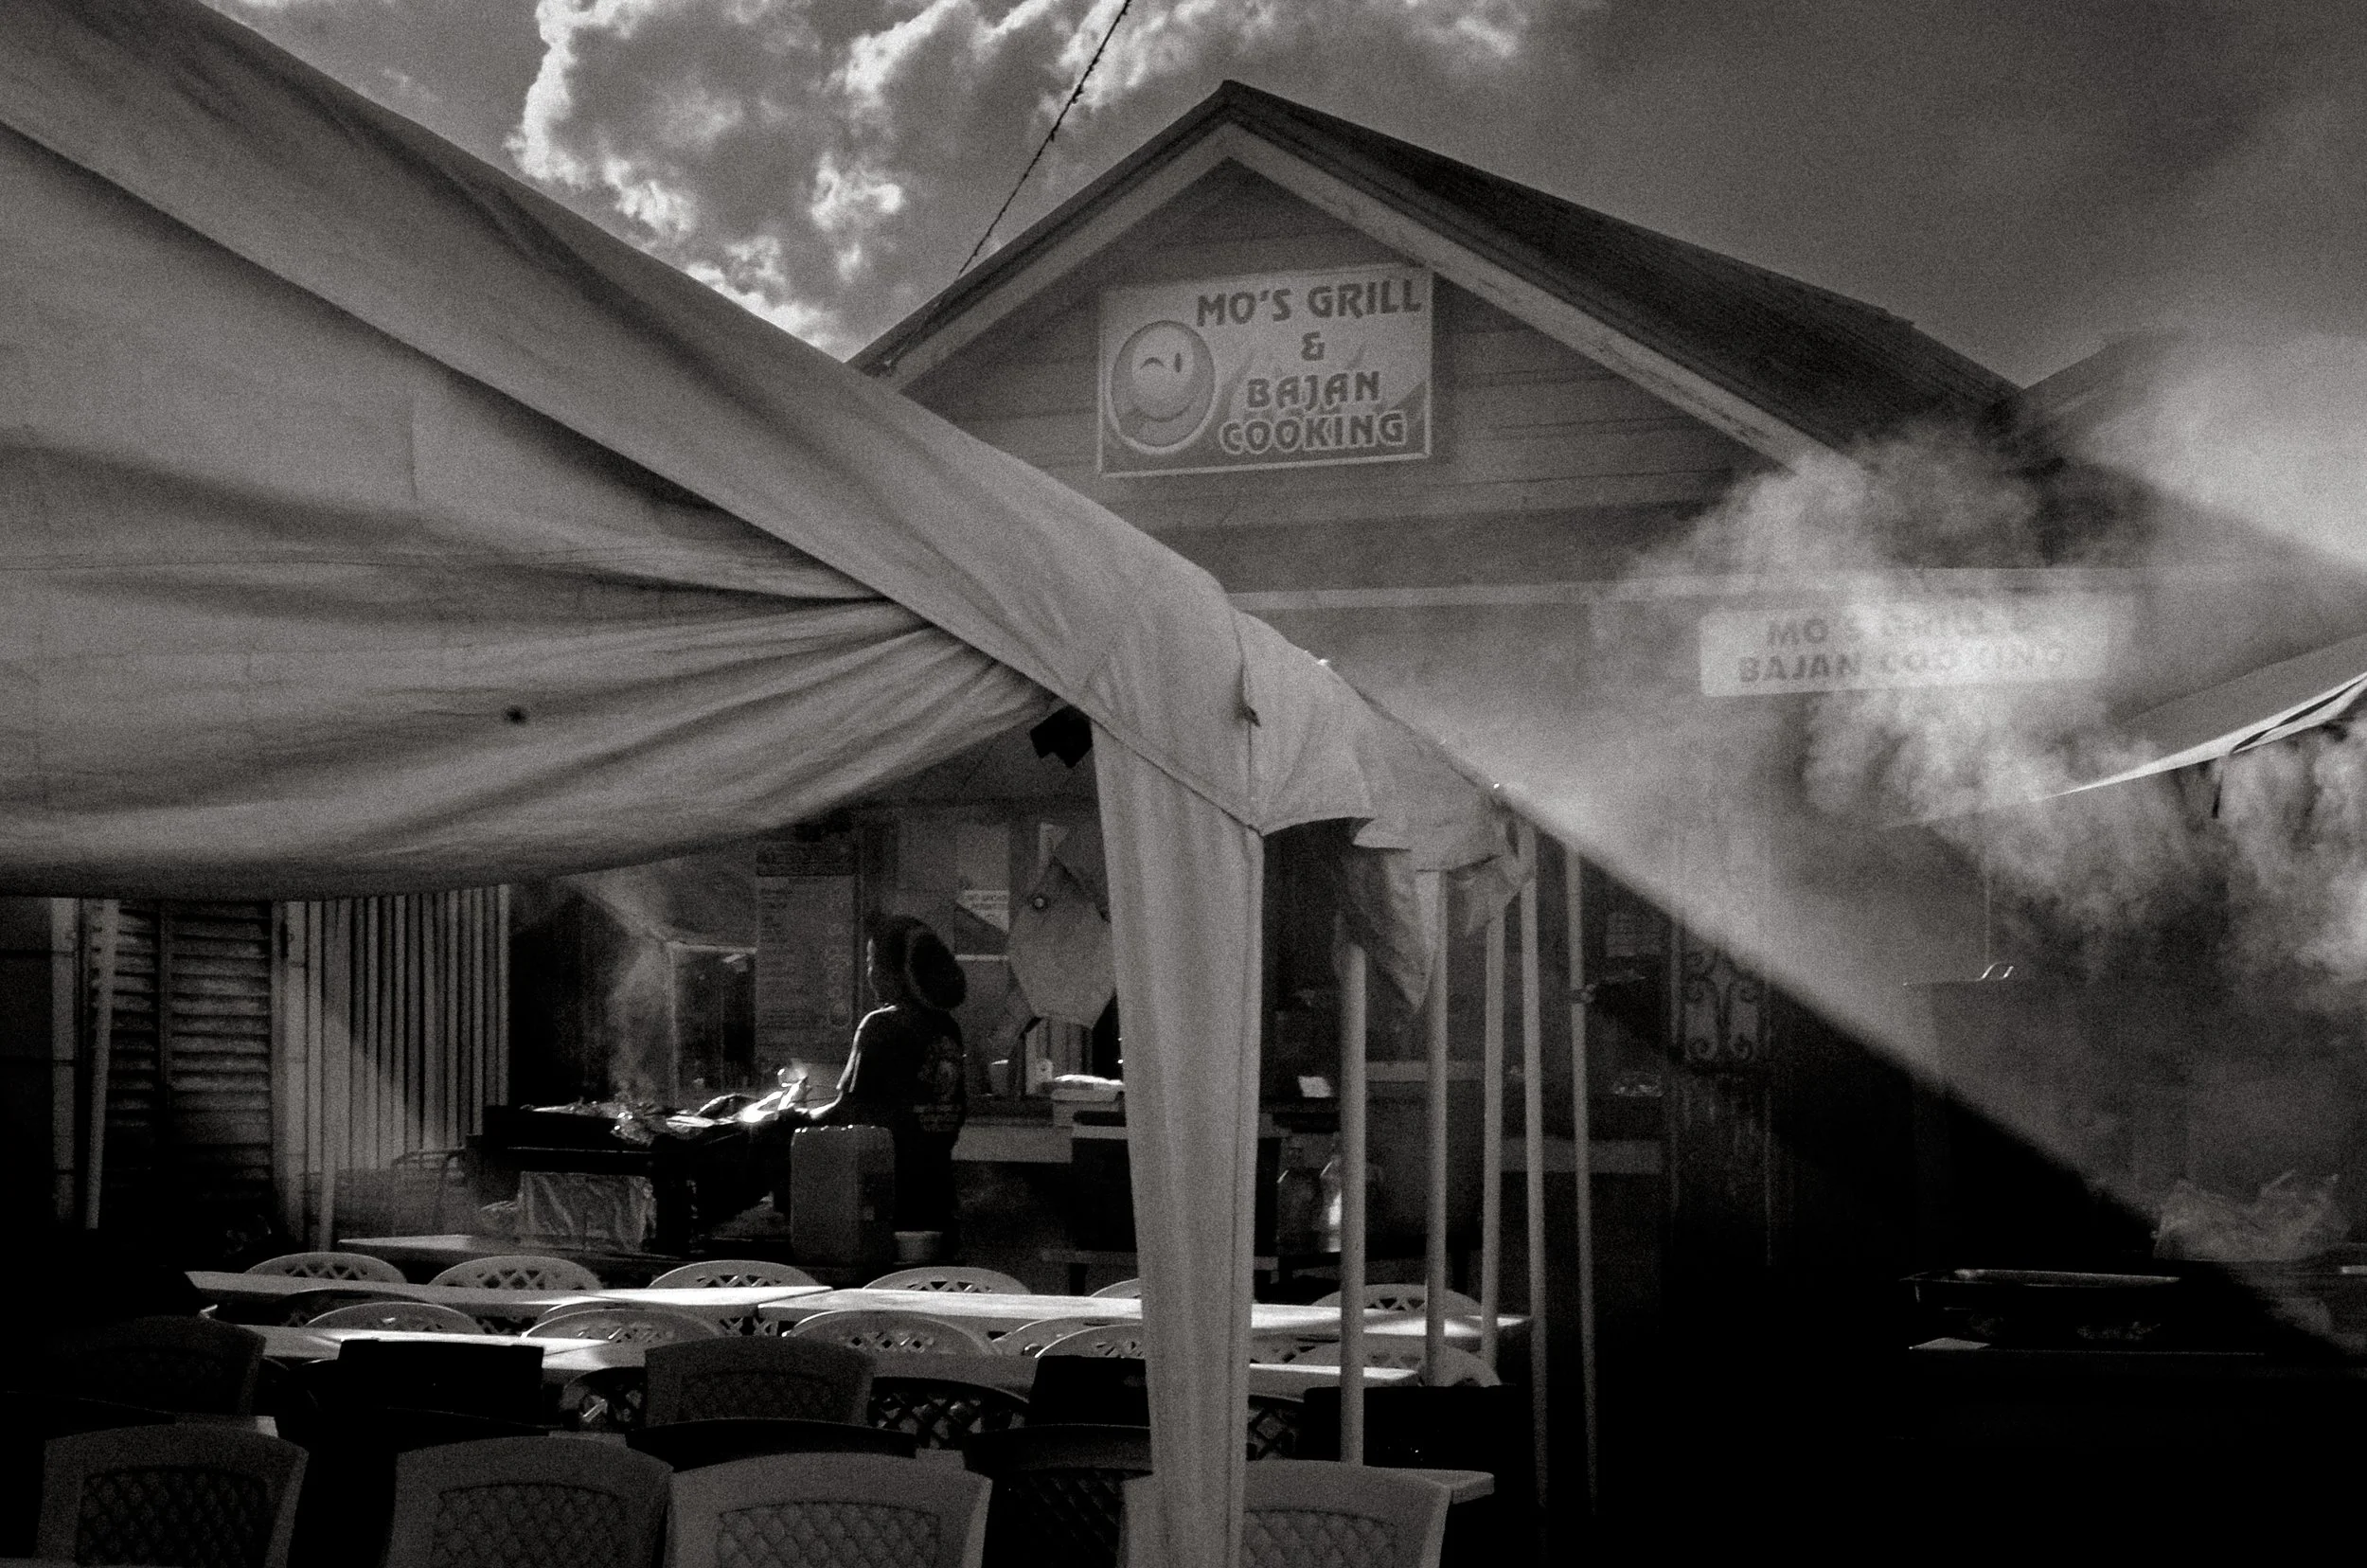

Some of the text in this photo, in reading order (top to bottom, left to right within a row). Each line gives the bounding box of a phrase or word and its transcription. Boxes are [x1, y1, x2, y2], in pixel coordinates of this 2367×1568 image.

[1196, 278, 1422, 327] MO'S GRILL
[1301, 330, 1326, 361] &
[1247, 370, 1379, 412] BAJAN
[1220, 411, 1407, 454] COOKING
[1739, 652, 1862, 683] BAJAN
